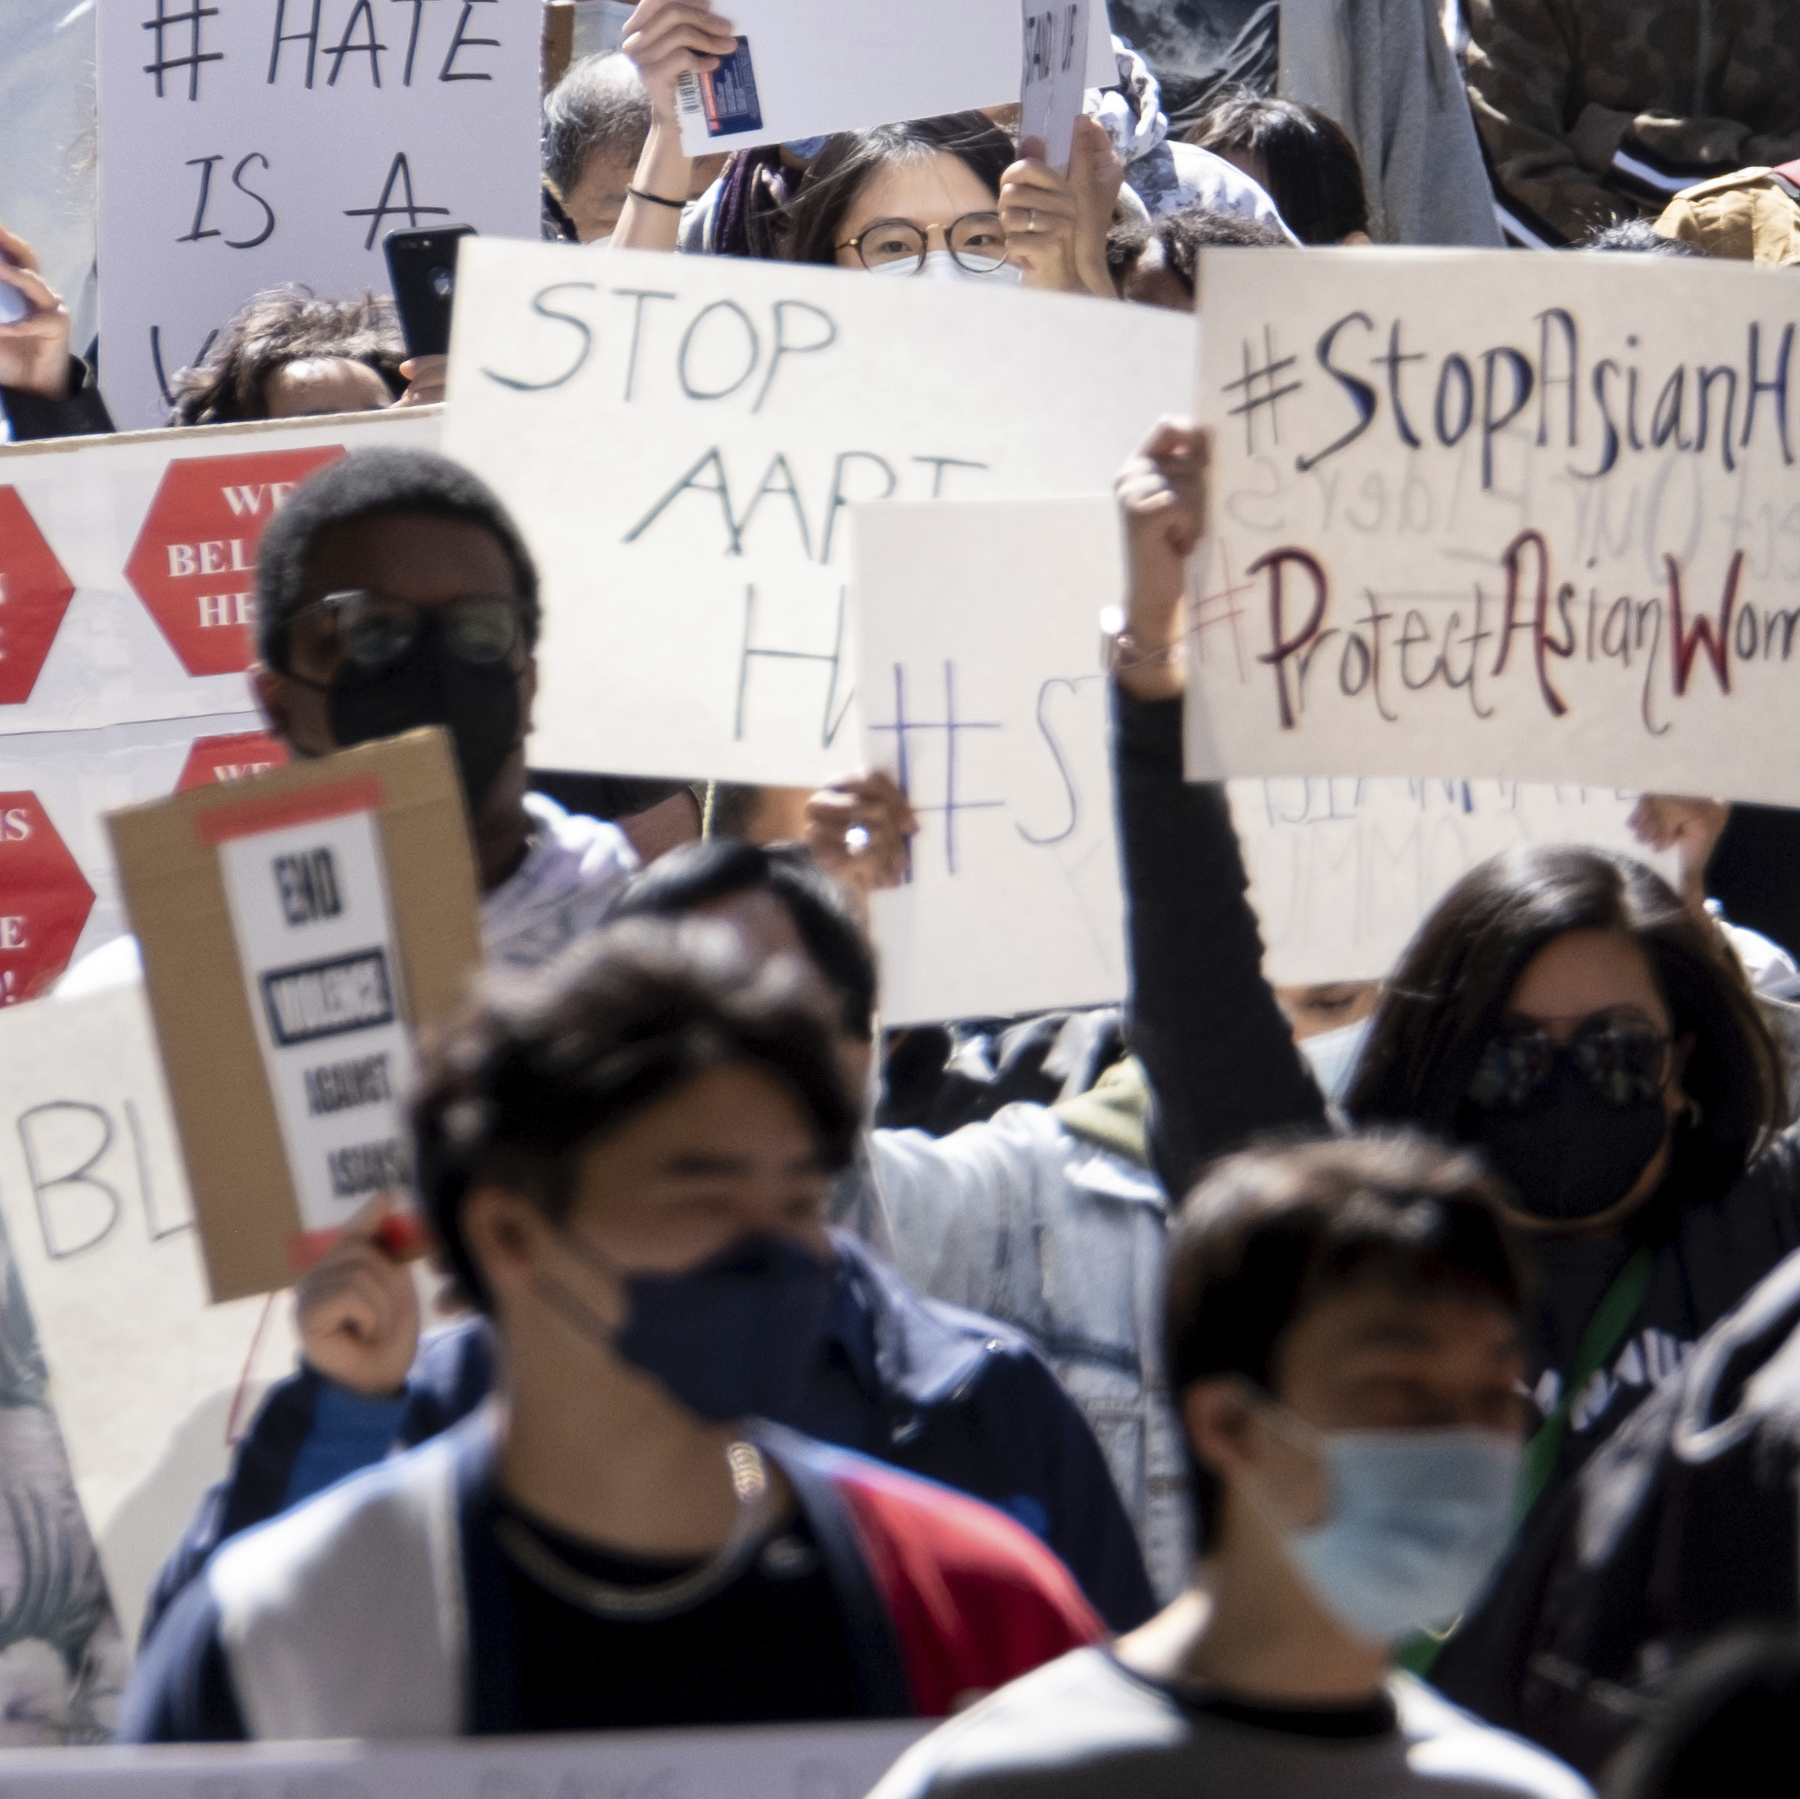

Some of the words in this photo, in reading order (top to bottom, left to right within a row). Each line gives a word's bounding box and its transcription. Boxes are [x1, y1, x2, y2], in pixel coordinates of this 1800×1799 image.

[175, 152, 276, 250] IS
[344, 152, 451, 251] A
[480, 280, 838, 413] STOP
